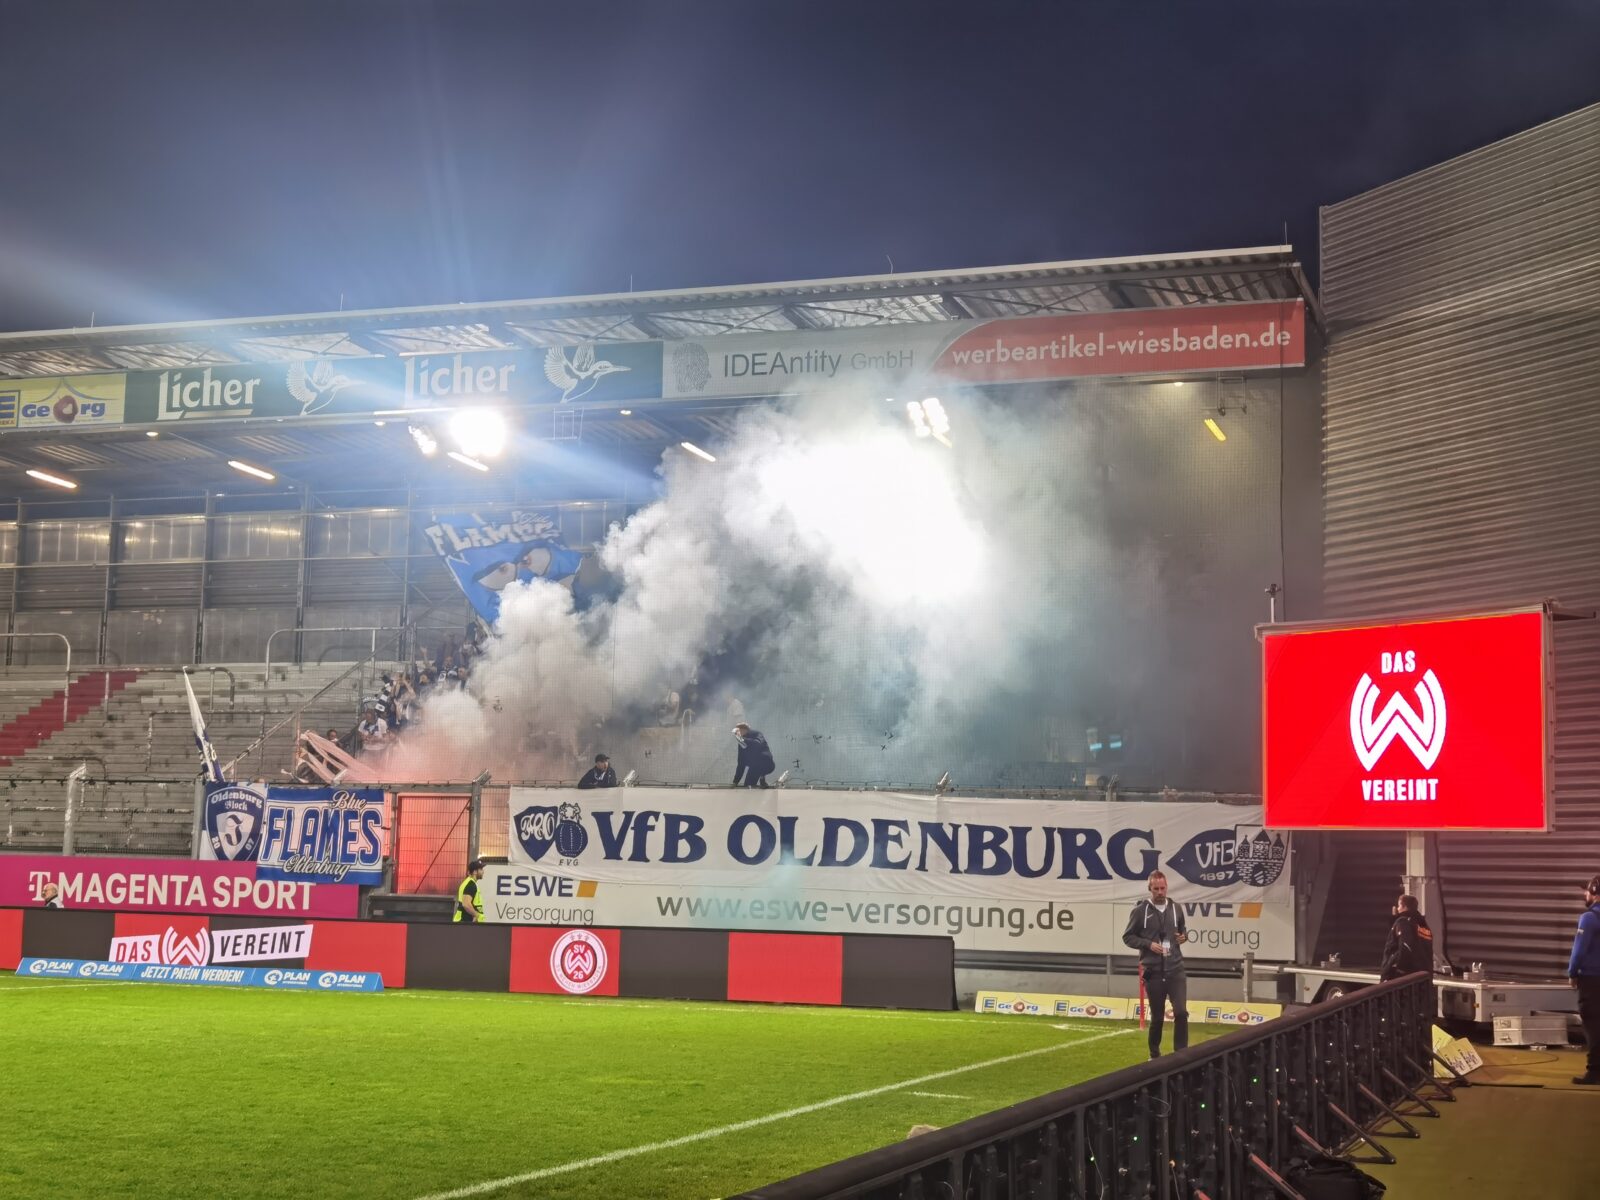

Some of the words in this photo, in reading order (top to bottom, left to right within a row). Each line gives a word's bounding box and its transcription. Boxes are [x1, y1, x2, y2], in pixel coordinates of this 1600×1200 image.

[952, 321, 1292, 365] werbeartikel-wiesbaden.de
[724, 350, 842, 377] IDEAntity
[851, 350, 914, 370] GmbH
[403, 353, 516, 404] Licher
[156, 367, 260, 421] Licher
[1381, 650, 1416, 674] DAS
[211, 789, 263, 809] Oldenburg
[331, 790, 367, 810] Blue
[1361, 778, 1439, 801] VEREINT
[260, 805, 383, 865] FLAMES
[591, 810, 708, 864] VfB
[727, 813, 1162, 881] OLDENBURG
[1195, 840, 1236, 868] VfB
[284, 853, 350, 882] Oldenburg
[1199, 870, 1235, 881] 1897
[58, 872, 209, 906] MAGENTA
[213, 875, 317, 910] SPORT
[496, 875, 574, 898] ESWE
[496, 902, 595, 925] Versorgung
[656, 896, 1075, 937] www.eswe-versorgung.de
[116, 940, 153, 963] DAS
[220, 930, 306, 957] VEREINT
[573, 945, 586, 954] SV
[1187, 928, 1261, 950] orgung
[48, 961, 74, 970] PLAN
[98, 964, 124, 973] PLAN
[141, 966, 171, 979] JETZT
[201, 969, 245, 983] WERDEN!
[283, 971, 311, 981] PLAN
[573, 971, 584, 980] 26
[338, 974, 366, 984] PLAN
